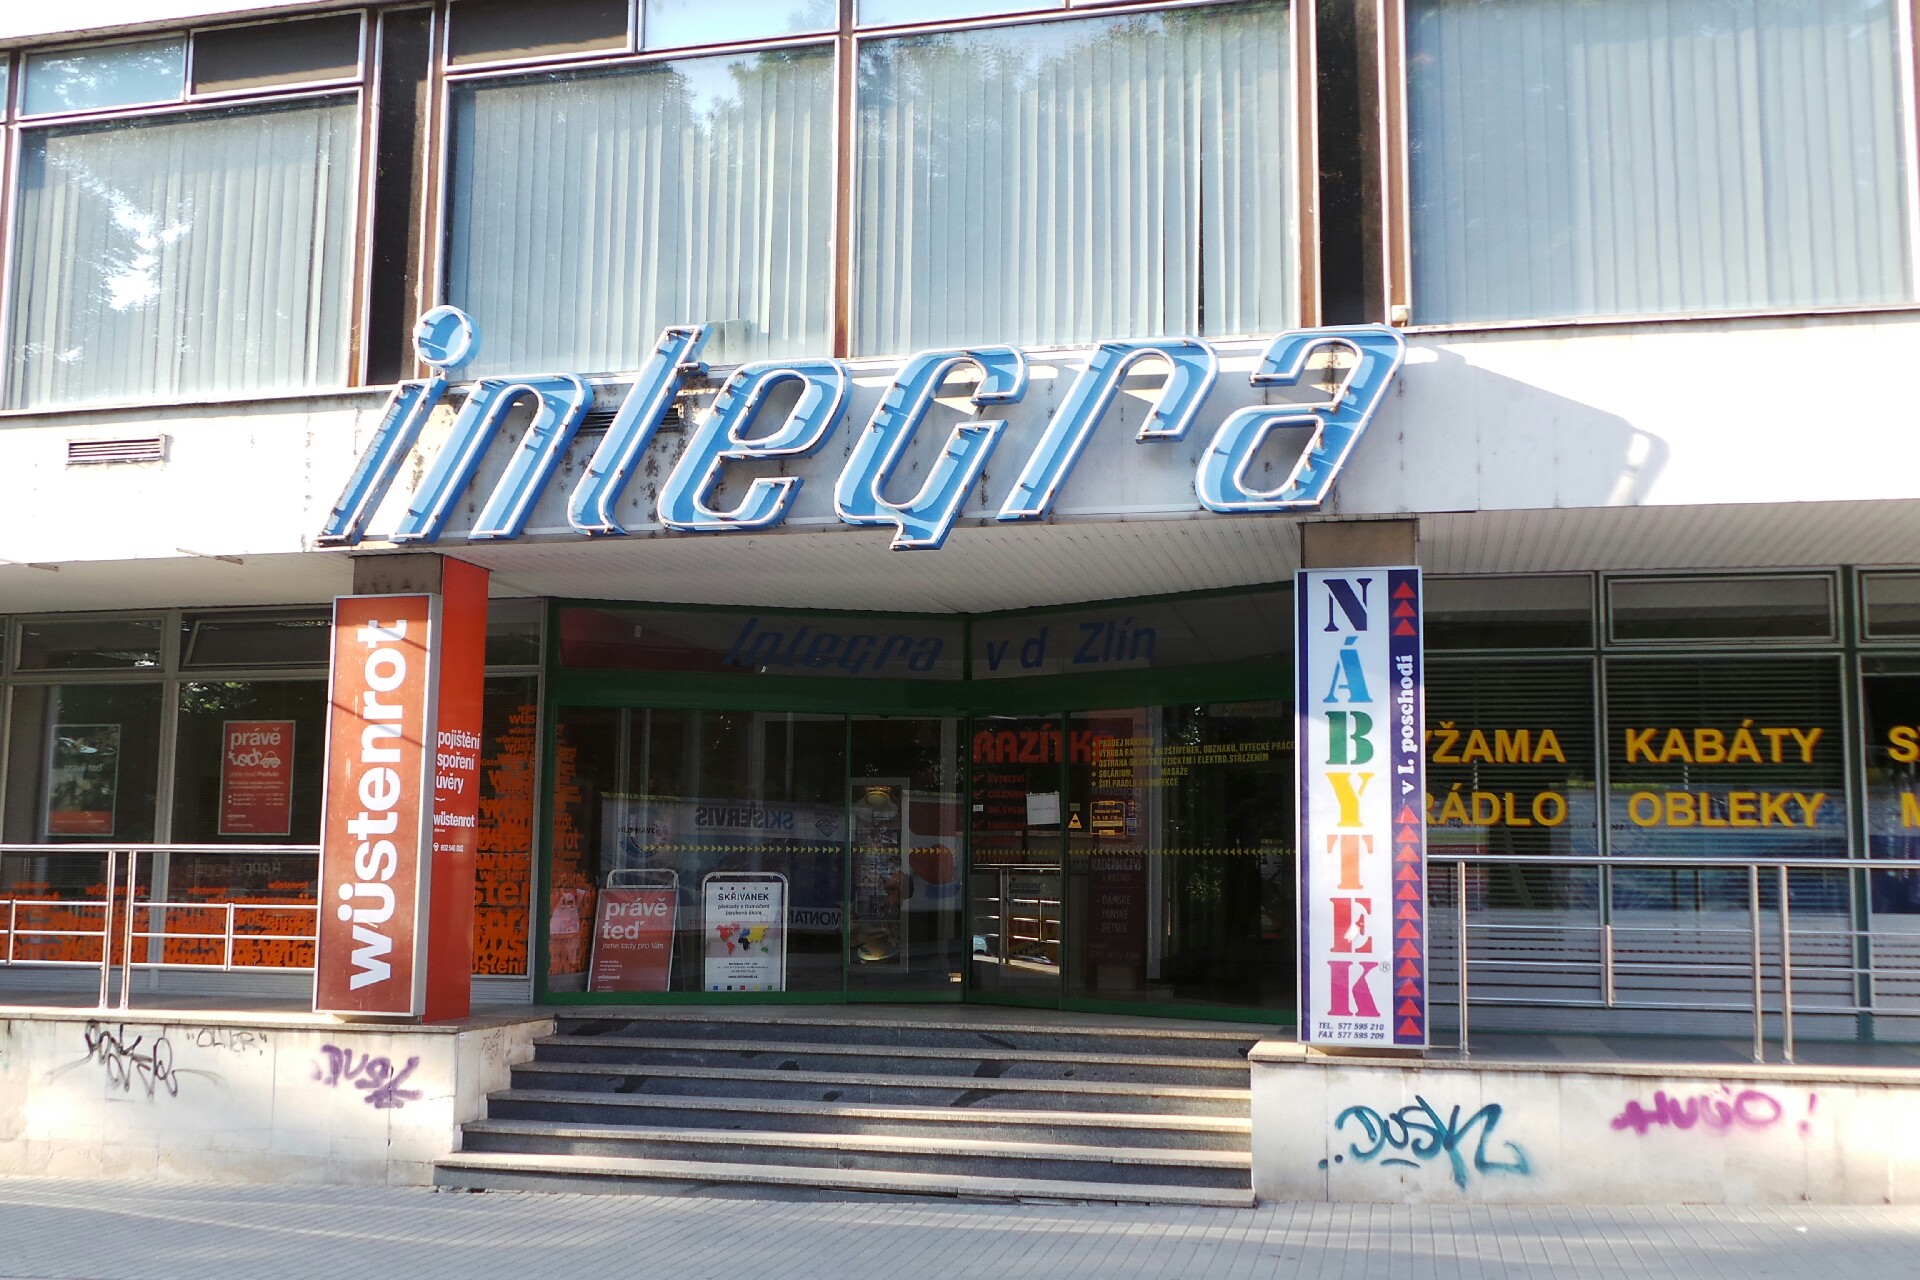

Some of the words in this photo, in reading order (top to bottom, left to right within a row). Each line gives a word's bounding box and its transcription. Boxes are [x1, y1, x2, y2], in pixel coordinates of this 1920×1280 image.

[317, 303, 1407, 550] integra
[722, 617, 944, 675] Integra
[986, 642, 1009, 672] v
[1020, 627, 1049, 669] d
[1073, 616, 1158, 666] Zlín
[1395, 654, 1418, 754] poschodí
[231, 728, 281, 750] právě
[438, 729, 481, 750] pojištění
[1625, 719, 1824, 764] KABÁTY
[436, 751, 476, 771] spoření
[435, 771, 464, 795] úvěry
[337, 619, 407, 991] wüstenrot
[1322, 578, 1381, 1017] NÁBYTEK
[1627, 791, 1827, 828] OBLEKY
[433, 811, 475, 828] wüstenrot
[605, 897, 668, 921] právě
[718, 892, 770, 902] SKŘIVÁNEK
[602, 920, 646, 940] teď
[1318, 1022, 1334, 1030] TEL.
[1337, 1022, 1352, 1030] 577
[1354, 1022, 1369, 1031] 595
[1369, 1023, 1385, 1032] 210
[1318, 1031, 1334, 1039] FAX
[1337, 1031, 1352, 1039] 577
[1354, 1031, 1369, 1040] 595
[1369, 1032, 1385, 1041] 209
